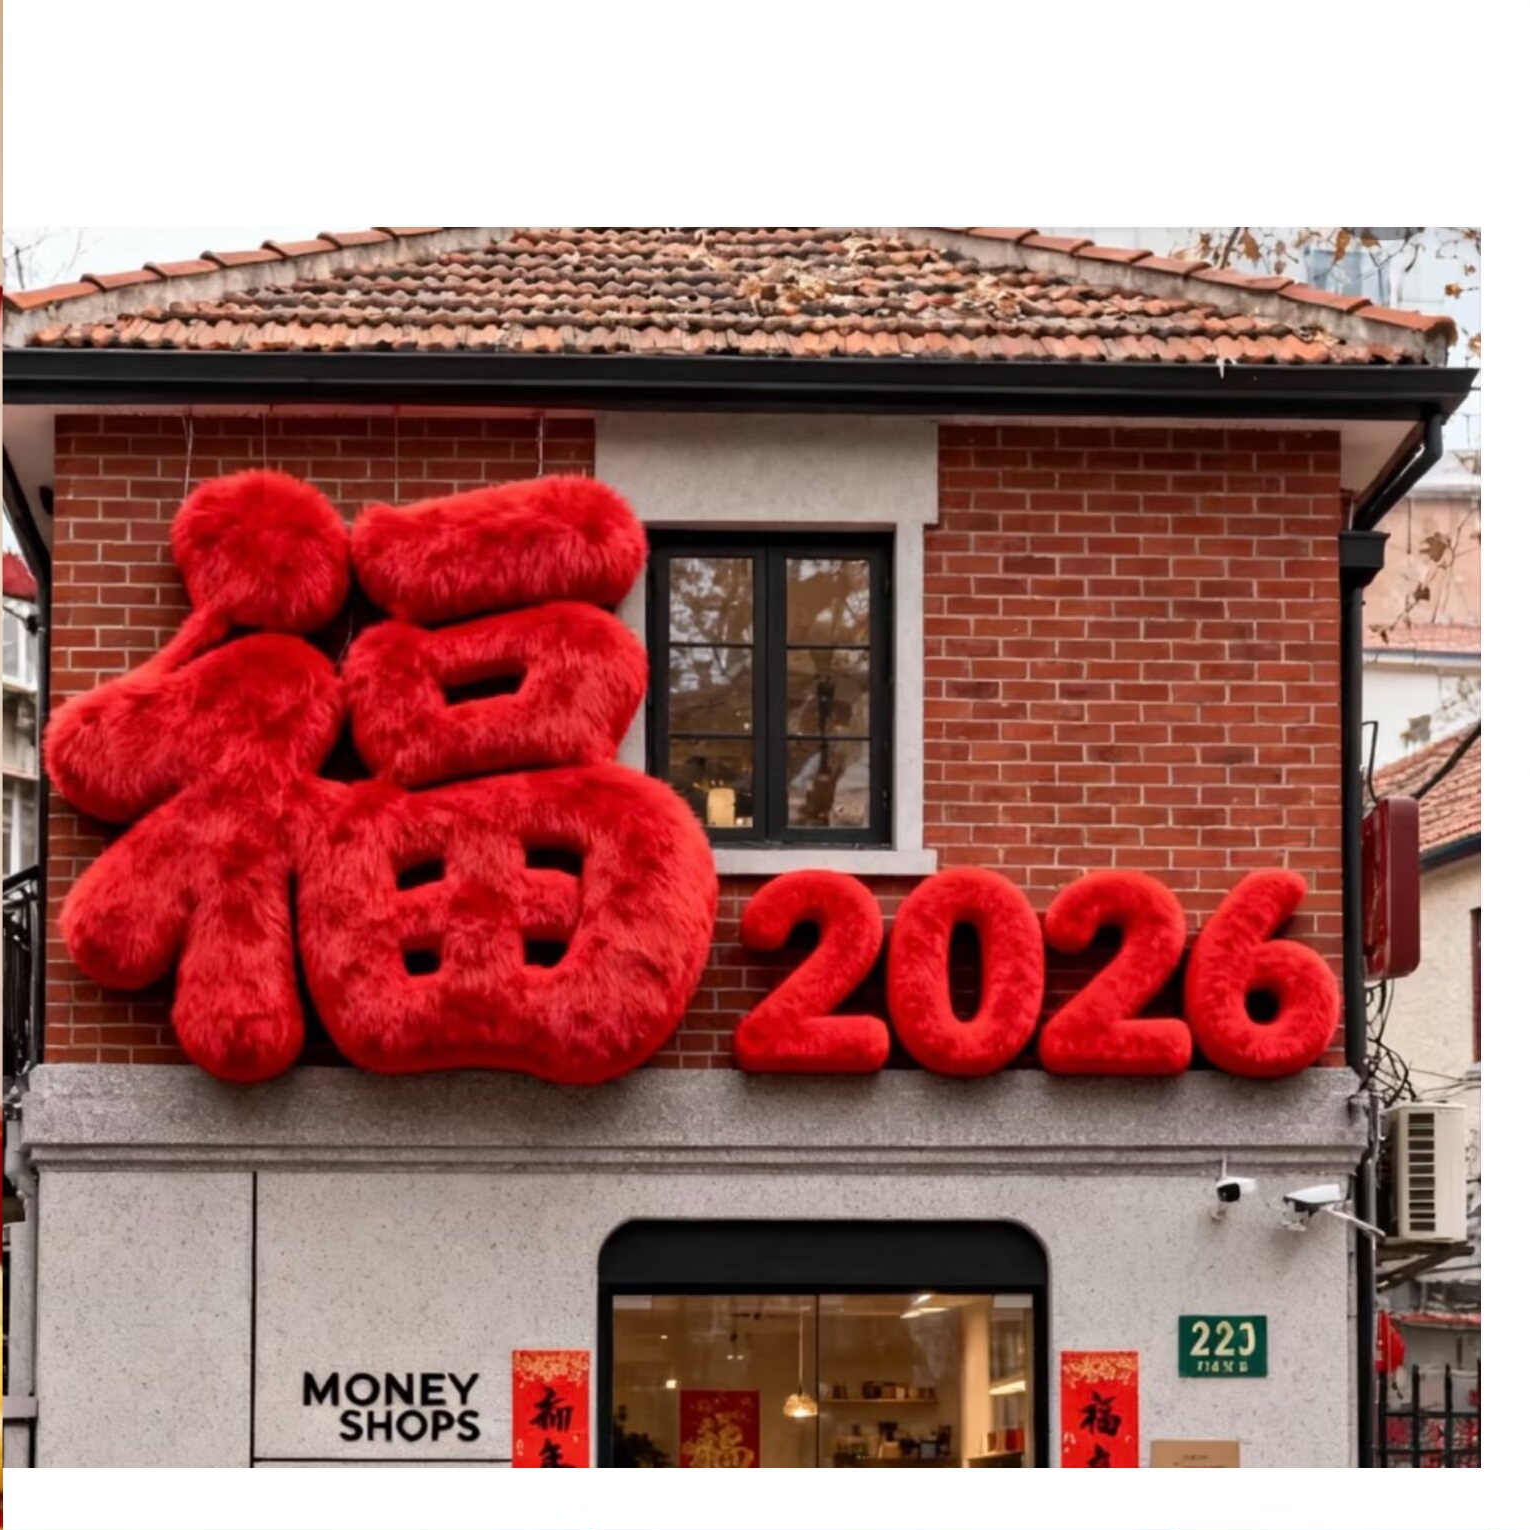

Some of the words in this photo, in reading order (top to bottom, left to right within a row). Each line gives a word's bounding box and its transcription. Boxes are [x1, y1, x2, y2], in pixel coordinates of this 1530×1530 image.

[45, 468, 718, 1084] 福
[733, 866, 1340, 1078] 2026
[302, 1371, 481, 1407] MONEY
[339, 1410, 481, 1443] SHOPS
